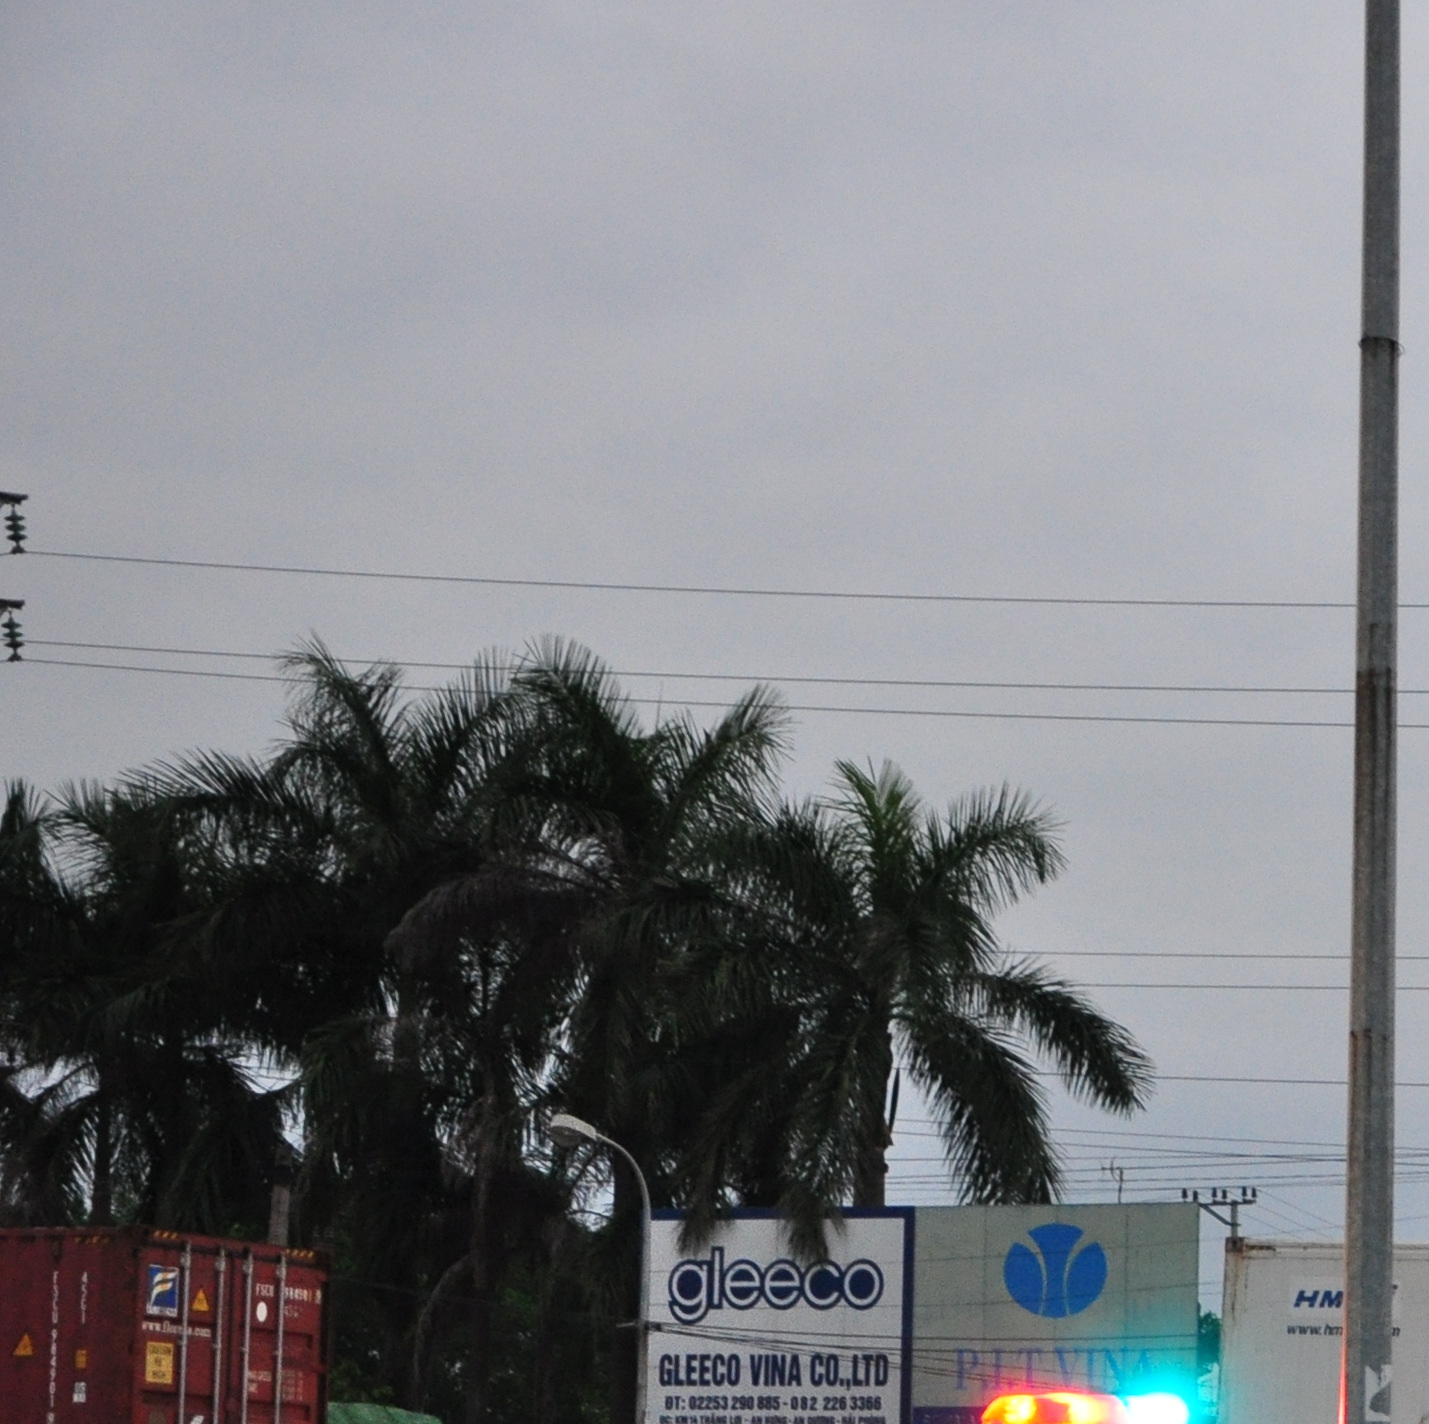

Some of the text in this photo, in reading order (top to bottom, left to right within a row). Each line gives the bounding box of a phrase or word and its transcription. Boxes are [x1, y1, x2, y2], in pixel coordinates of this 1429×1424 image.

[668, 1246, 884, 1325] gleeco
[659, 1353, 889, 1391] GLEECO VINA CO.,LTD
[688, 1395, 728, 1411] 02253
[731, 1395, 755, 1411] 290
[822, 1395, 847, 1411] 226
